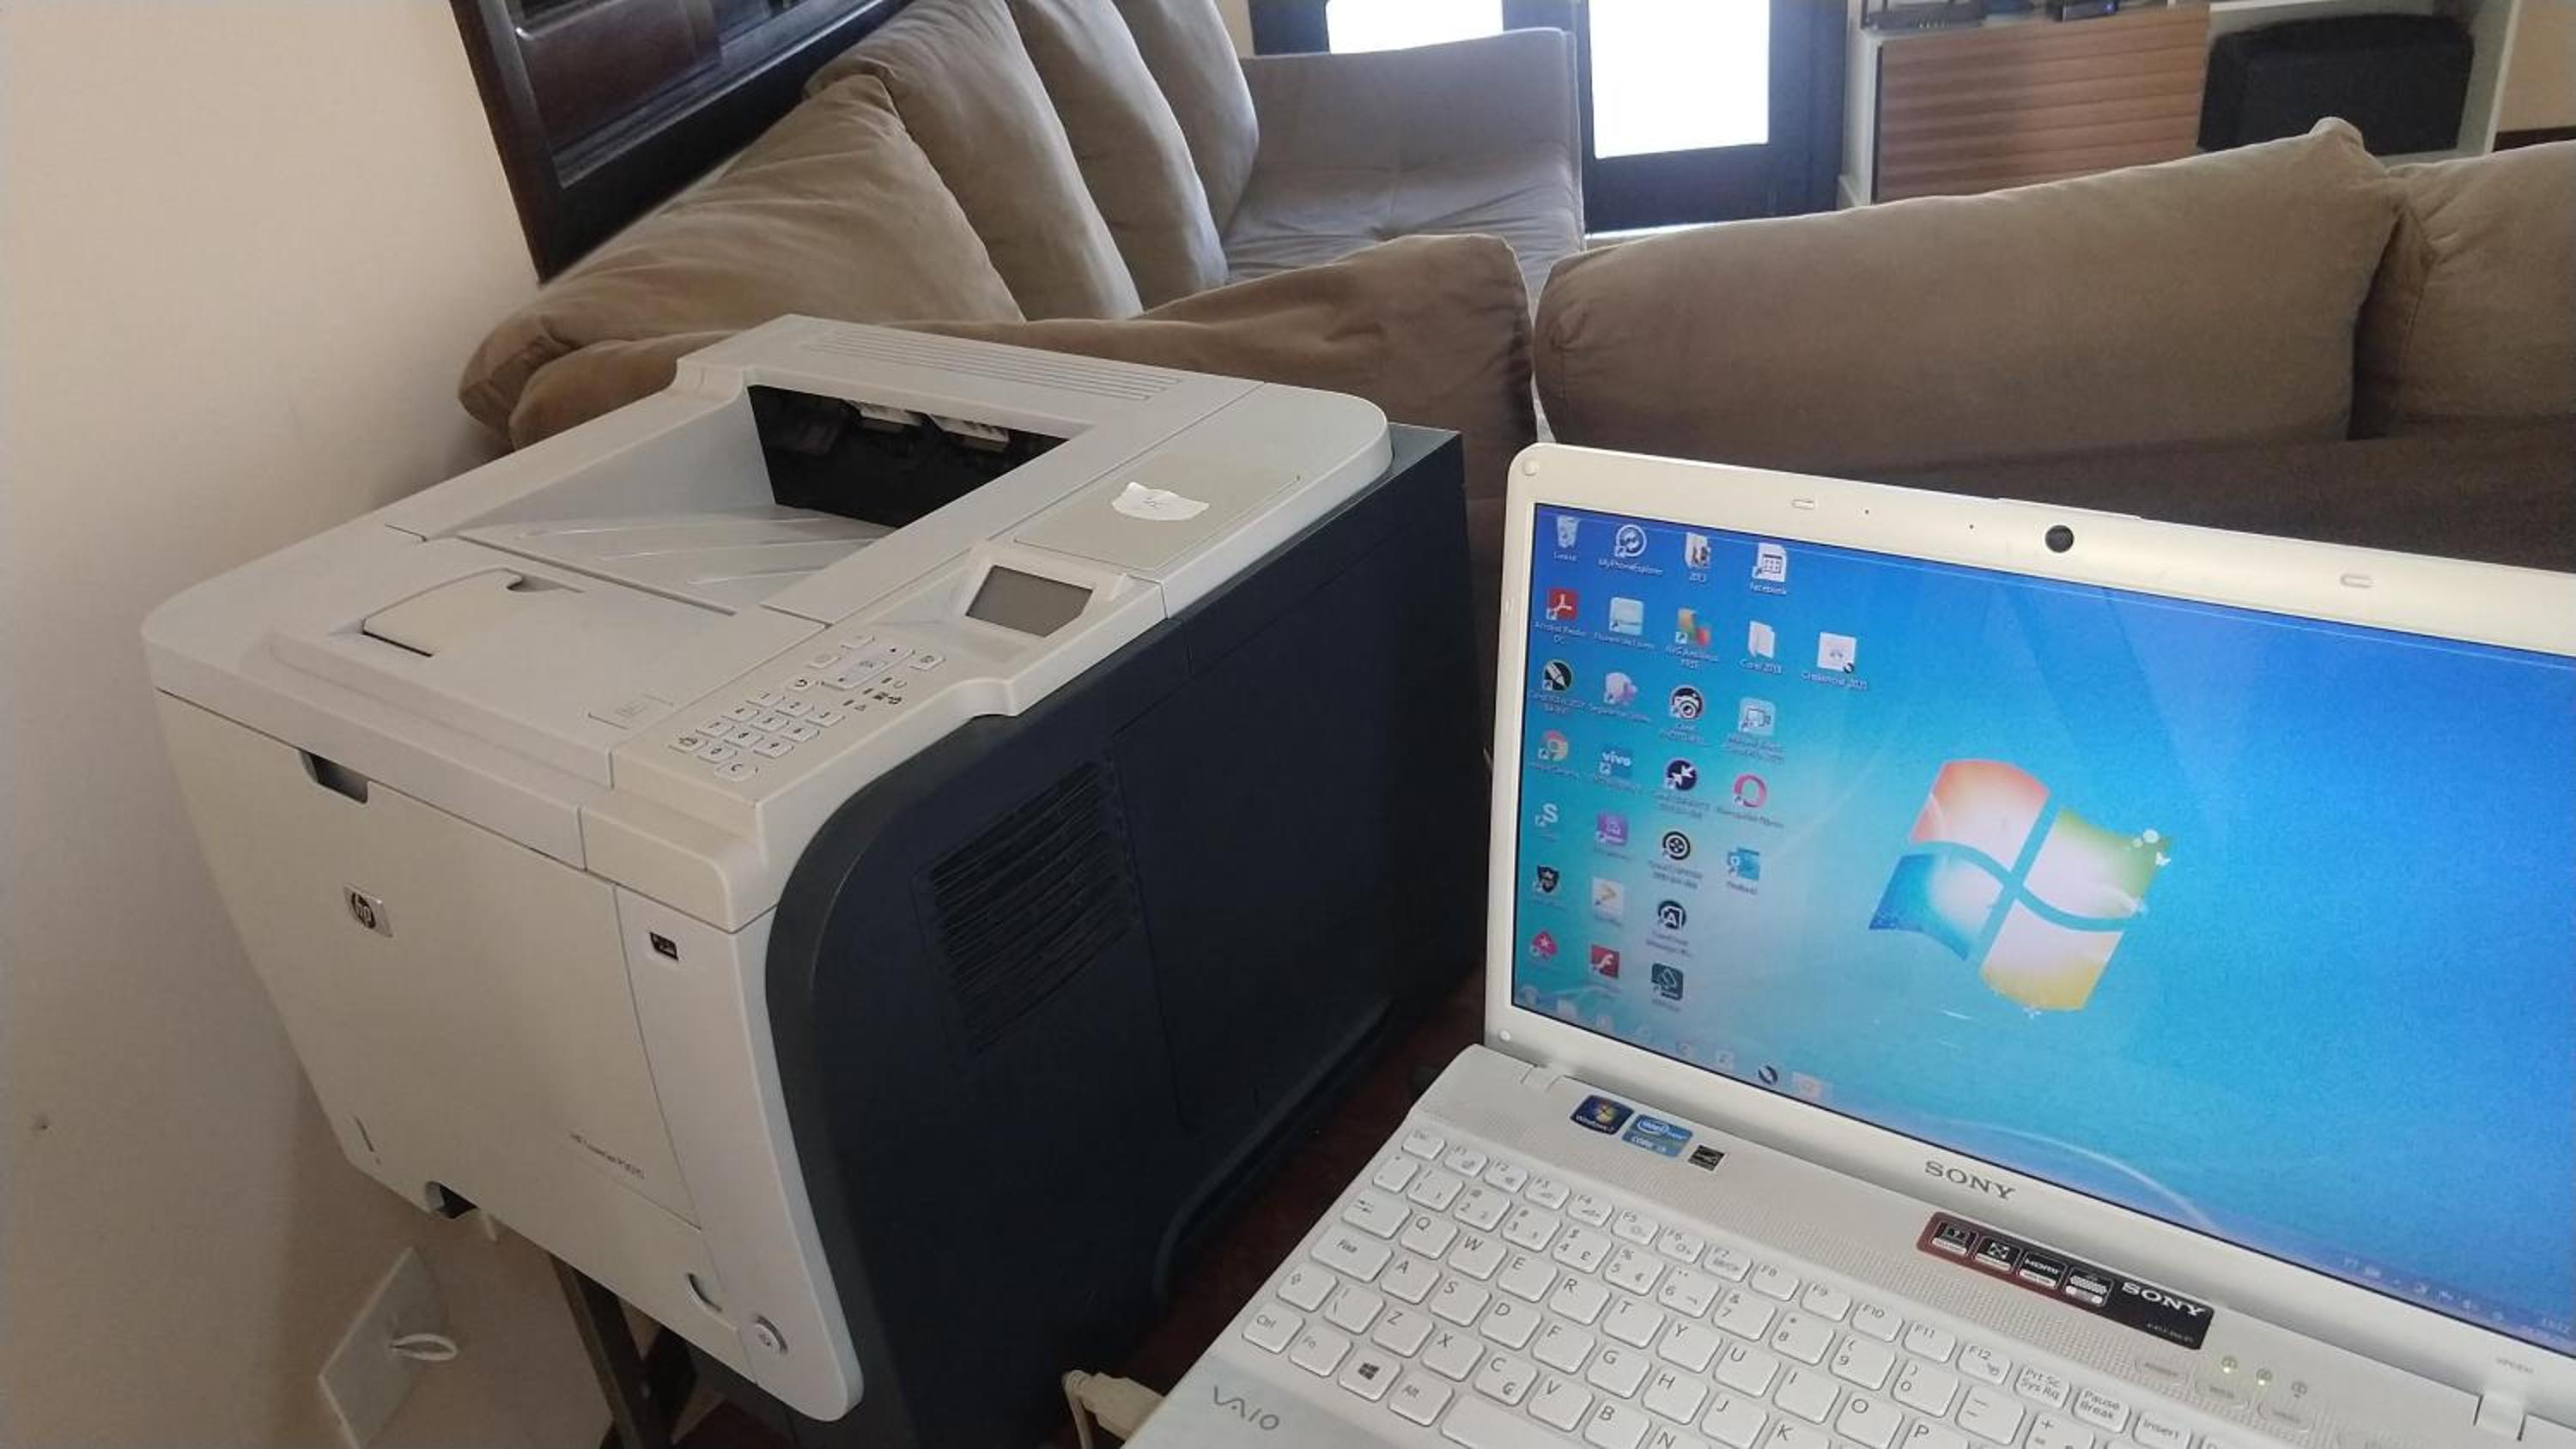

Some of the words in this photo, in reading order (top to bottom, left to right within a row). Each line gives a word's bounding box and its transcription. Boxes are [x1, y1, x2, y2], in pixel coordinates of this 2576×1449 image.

[1602, 751, 1631, 767] vivo
[1924, 1160, 2016, 1200] SONY
[1460, 1203, 1471, 1214] 2
[1415, 1216, 1431, 1232] Q
[1463, 1236, 1484, 1252] W
[1559, 1242, 1571, 1253] 4
[1395, 1259, 1410, 1275] A
[1512, 1256, 1526, 1270] E
[1611, 1263, 1622, 1274] 5
[1760, 1264, 1777, 1277] F8
[1443, 1280, 1456, 1294] S
[1563, 1279, 1577, 1293] R
[1664, 1285, 1675, 1297] 6
[2121, 1281, 2206, 1316] SONY
[1494, 1302, 1511, 1318] D
[1620, 1301, 1635, 1315] T
[1722, 1307, 1733, 1319] 7
[1862, 1304, 1886, 1319] F10
[1255, 1313, 1277, 1330] Ctrl
[1387, 1311, 1403, 1326] Z
[1546, 1325, 1562, 1339] F
[1674, 1323, 1689, 1337] Y
[1779, 1331, 1789, 1343] 8
[1914, 1324, 1935, 1338] F11
[1303, 1336, 1317, 1349] Fn
[1437, 1333, 1455, 1349] X
[1602, 1349, 1619, 1365] G
[1730, 1349, 1747, 1363] U
[1969, 1345, 1992, 1360] F12
[1490, 1357, 1506, 1372] C
[1839, 1355, 1850, 1367] 9
[1546, 1379, 1561, 1395] V
[1656, 1374, 1676, 1390] H
[1401, 1384, 1420, 1399] Alt
[1716, 1400, 1731, 1413] J
[2084, 1389, 2120, 1410] Pause
[1212, 1385, 1280, 1432] VAIO
[1599, 1405, 1615, 1420] B
[2079, 1400, 2113, 1418] Break
[1777, 1423, 1793, 1440] K
[1913, 1424, 1929, 1438] P
[2143, 1418, 2179, 1440] Insert
[1656, 1431, 1677, 1448] N
